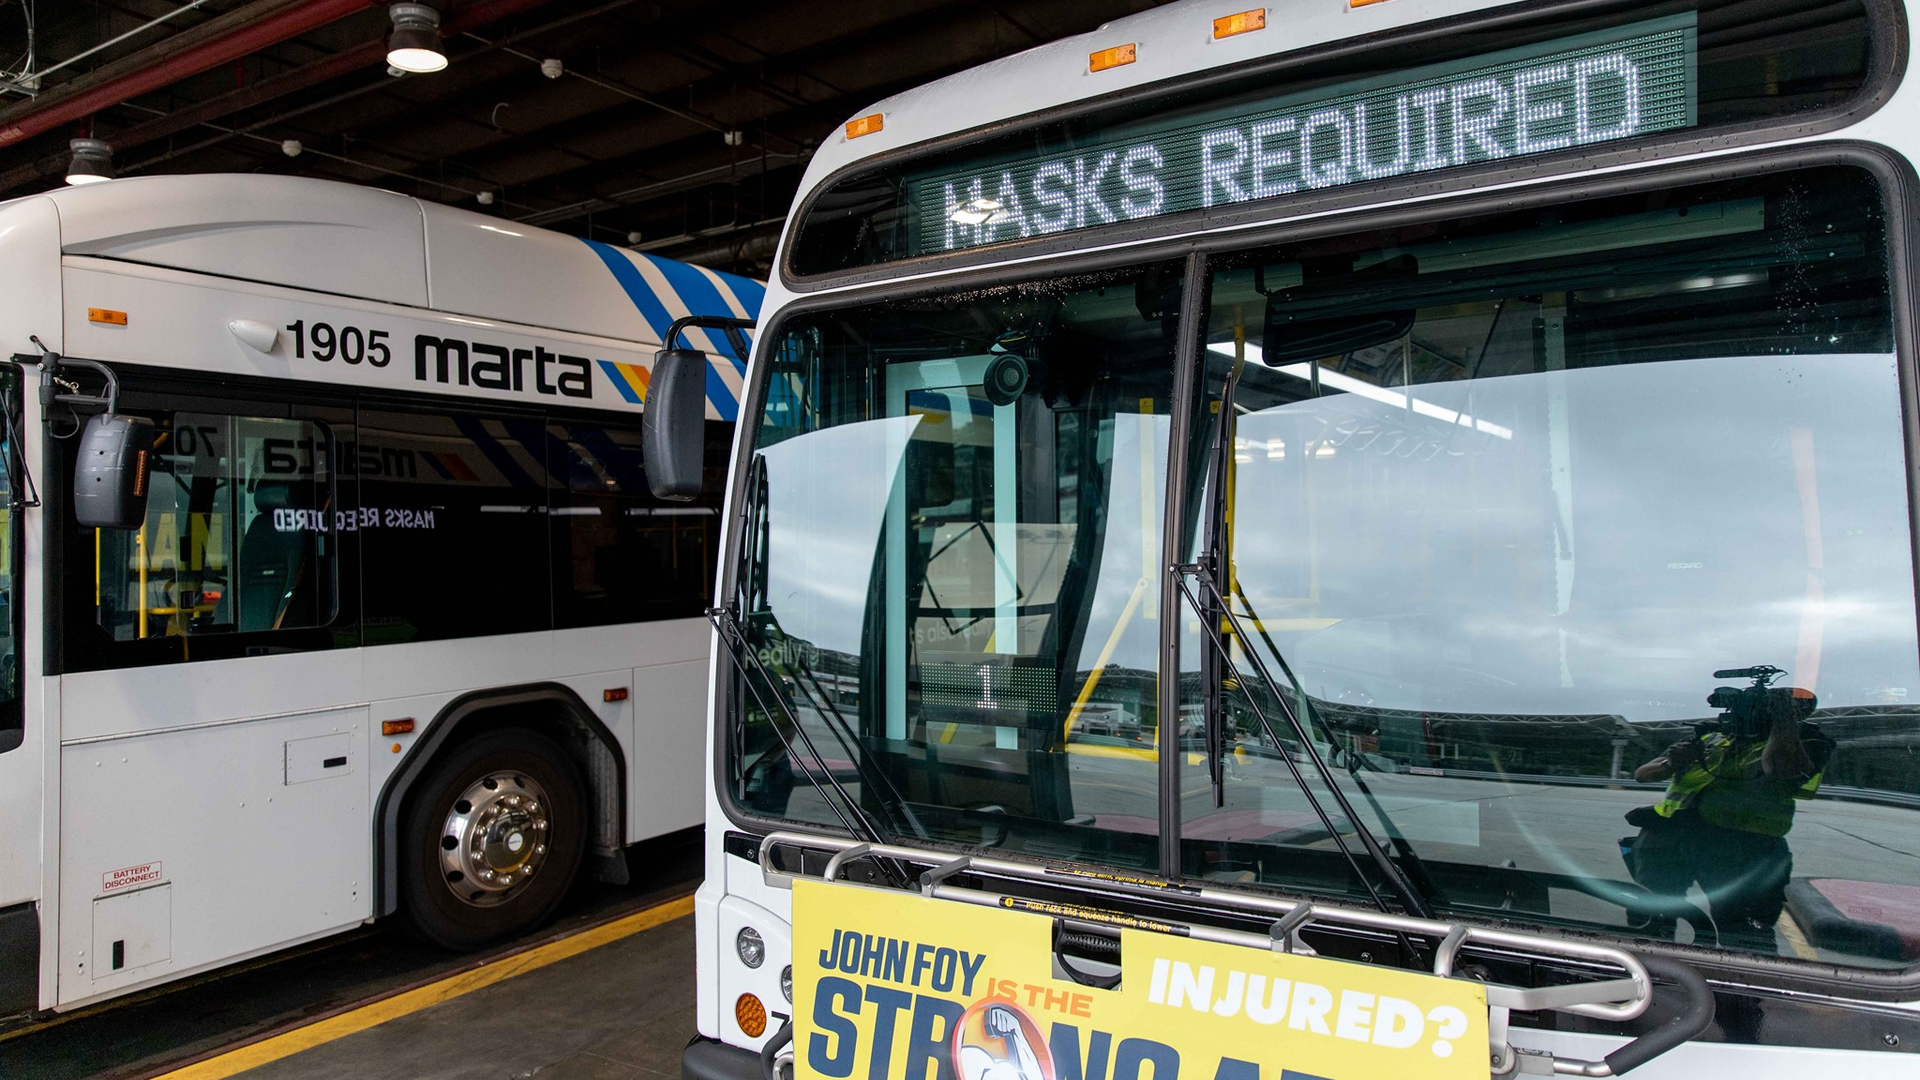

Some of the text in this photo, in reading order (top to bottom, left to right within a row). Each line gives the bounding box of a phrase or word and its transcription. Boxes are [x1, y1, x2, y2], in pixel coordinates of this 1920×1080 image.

[942, 54, 1639, 250] MASKS REQUIRED
[286, 319, 391, 368] 1905
[414, 334, 593, 399] marta
[976, 664, 997, 709] 1
[105, 871, 159, 889] DISCONNECT
[113, 865, 151, 879] BATTERY
[1063, 905, 1077, 917] and
[1079, 910, 1109, 923] squeeze
[1111, 914, 1137, 927] handle
[1138, 918, 1148, 928] to
[1149, 920, 1171, 932] lower
[818, 929, 986, 997] JOHN FOY
[986, 977, 1094, 1018] IS THE
[1148, 957, 1468, 1058] INJURED?
